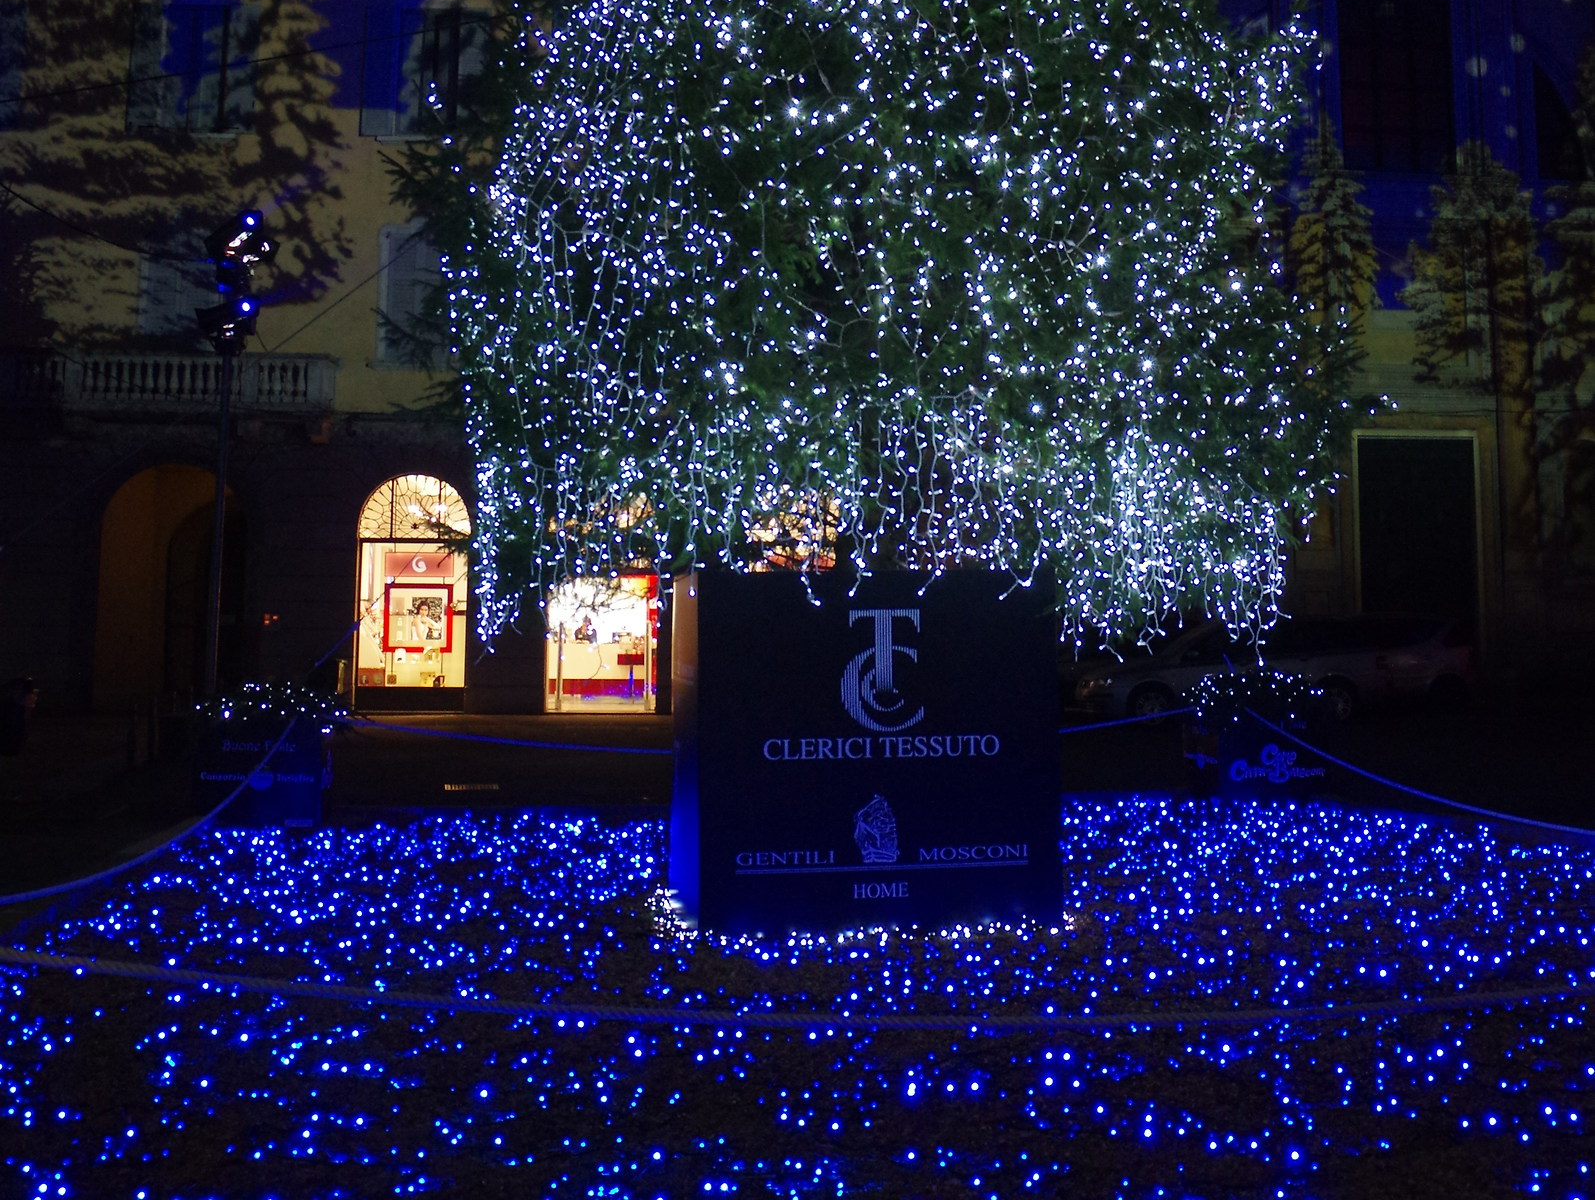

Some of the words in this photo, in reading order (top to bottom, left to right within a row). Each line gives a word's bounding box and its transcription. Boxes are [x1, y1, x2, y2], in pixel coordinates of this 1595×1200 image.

[762, 737, 872, 761] CLERICI
[879, 733, 1001, 759] TESSUTO
[735, 849, 836, 867] GENTILI
[918, 844, 1029, 862] MOSCONI
[852, 882, 910, 899] HOME
